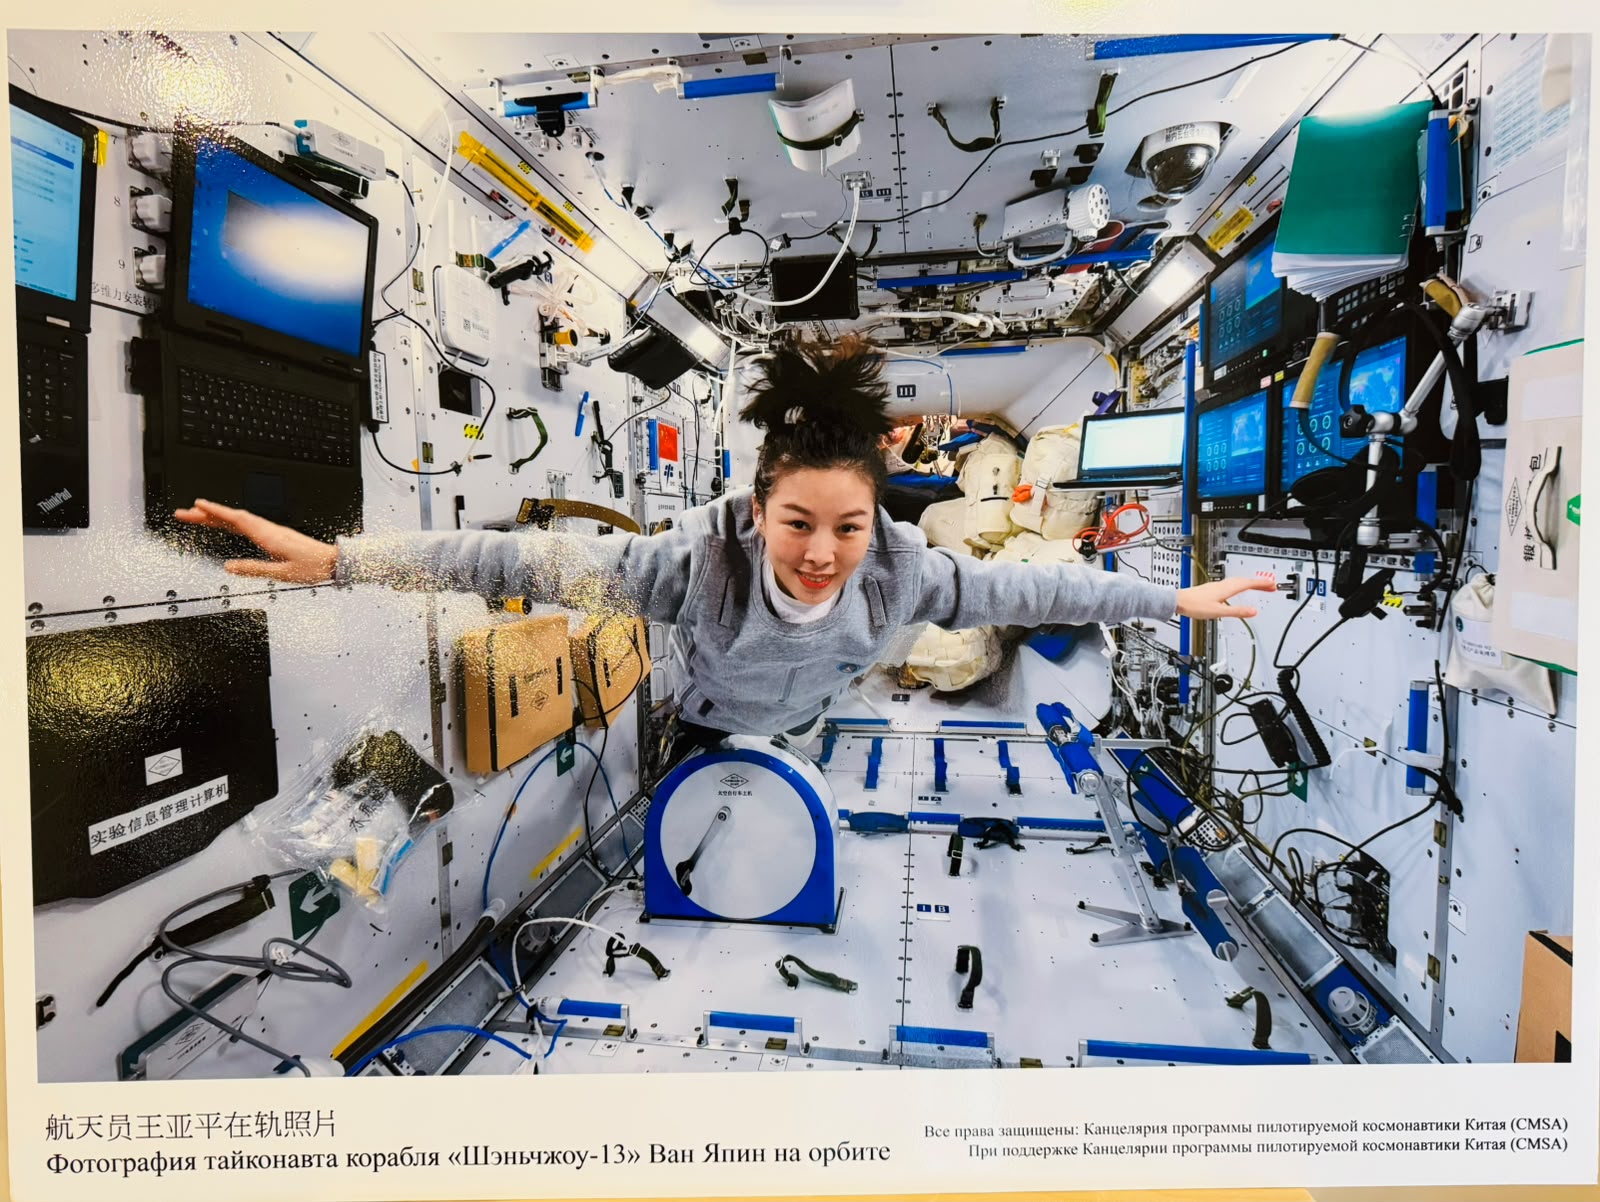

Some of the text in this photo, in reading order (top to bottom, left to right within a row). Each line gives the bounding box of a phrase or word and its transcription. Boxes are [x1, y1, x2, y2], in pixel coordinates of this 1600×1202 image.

[36, 487, 73, 513] ThinkPad
[91, 783, 229, 849] 实验信息管理计算机
[45, 1109, 336, 1142] 航天员王亚平在轨照片
[924, 1117, 1569, 1141] Все права защищены: Канцелярия программы пилотируемой космонавтики Китая (CMSA)
[46, 1140, 891, 1179] Фотография тайконавта корабля «Шэньчжоу-13» Ван Япин на орбите
[969, 1136, 1569, 1161] При поддержке Канцелярии программы пилотируемой космонавтики Китая (CMSA)
